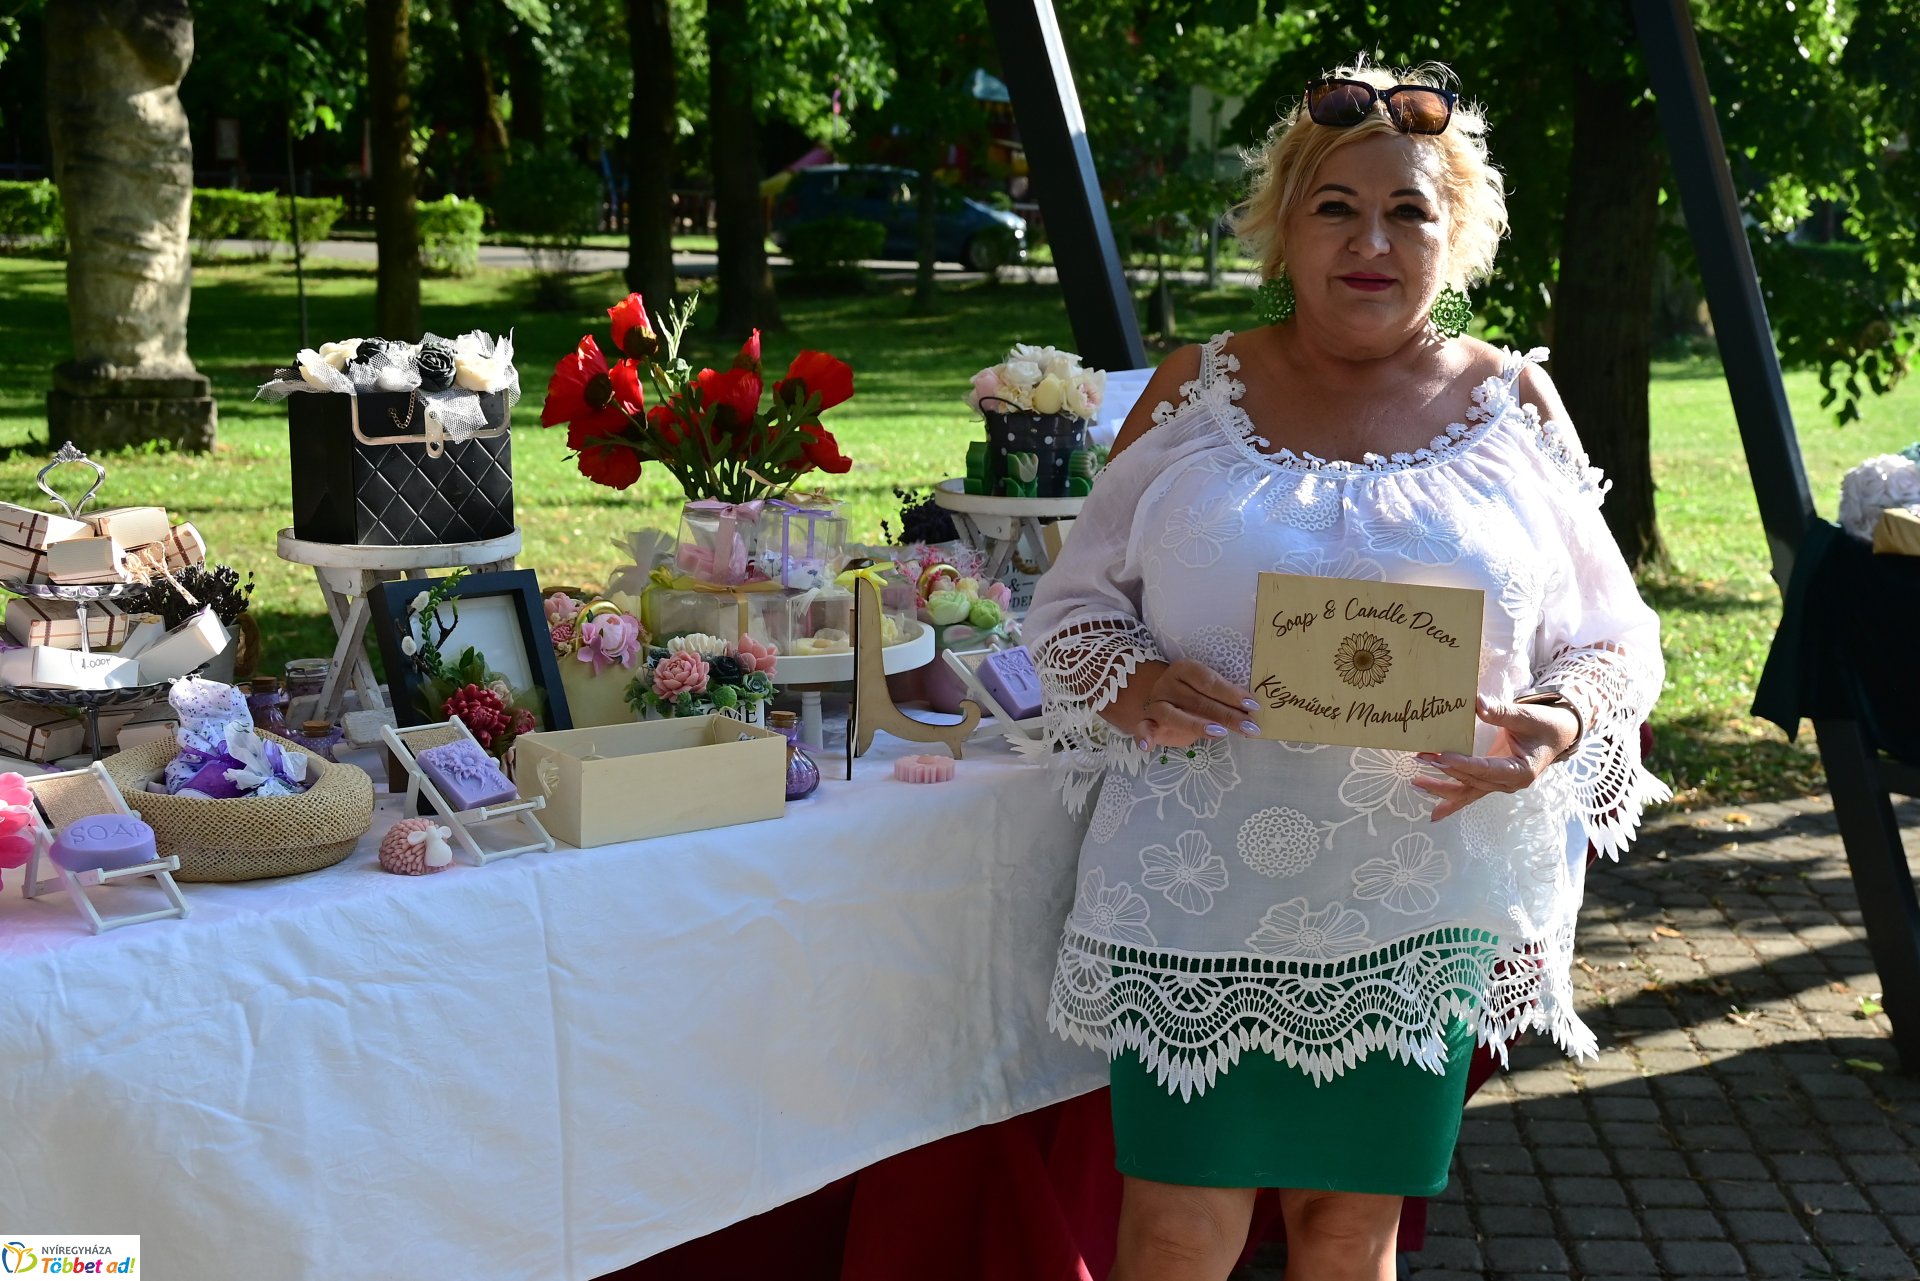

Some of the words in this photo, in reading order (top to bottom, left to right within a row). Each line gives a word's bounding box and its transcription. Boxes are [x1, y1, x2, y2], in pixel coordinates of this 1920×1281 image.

[1272, 610, 1317, 637] Soap
[1323, 599, 1336, 619] &
[1344, 597, 1408, 624] Candle
[1408, 611, 1460, 648] Decor
[1254, 674, 1342, 721] Kézműves
[1346, 695, 1467, 733] Manufaktúra
[70, 822, 147, 845] SOAP
